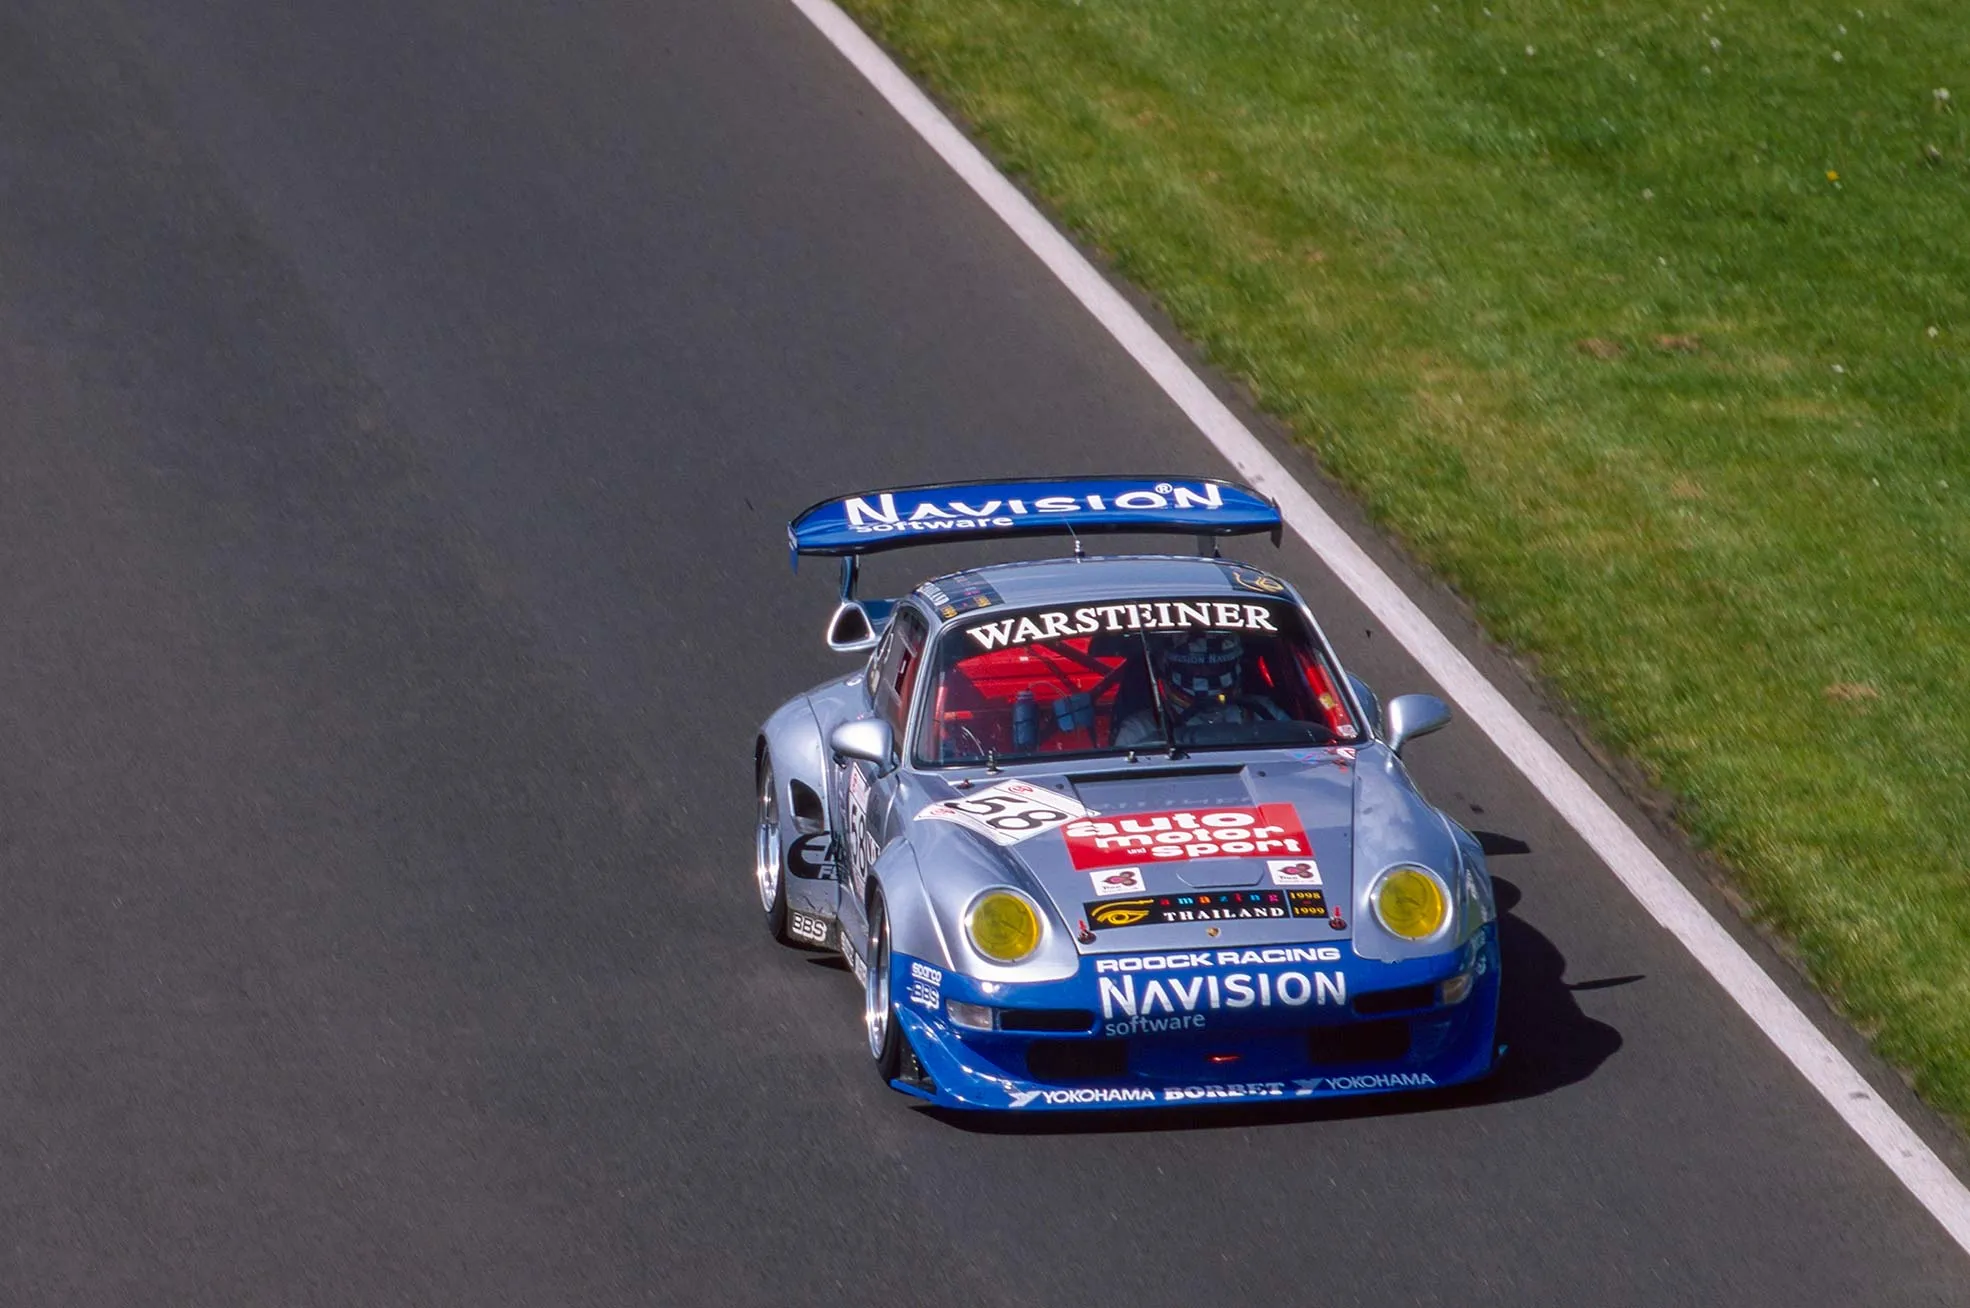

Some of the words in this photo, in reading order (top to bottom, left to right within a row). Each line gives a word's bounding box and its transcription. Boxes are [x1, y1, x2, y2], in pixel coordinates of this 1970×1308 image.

[856, 516, 1014, 533] software
[966, 602, 1278, 650] WARSTEINER
[944, 796, 1068, 831] 58
[1066, 812, 1256, 838] auto
[1096, 825, 1285, 849] motor
[1151, 838, 1302, 857] sport
[1290, 891, 1322, 900] 1998
[1163, 906, 1285, 922] THAILAND
[1293, 906, 1326, 915] 1999
[792, 914, 828, 942] BBS
[1096, 951, 1214, 973] ROOCK
[1217, 946, 1342, 966] RACING
[911, 962, 943, 983] sparco
[910, 980, 941, 1011] BBS
[1098, 970, 1347, 1020] NAVISION
[1105, 1013, 1207, 1037] software
[1163, 1081, 1285, 1101] BORBET
[1325, 1072, 1437, 1090] YOKOHAMA
[1042, 1087, 1157, 1105] YOKOHAMA
